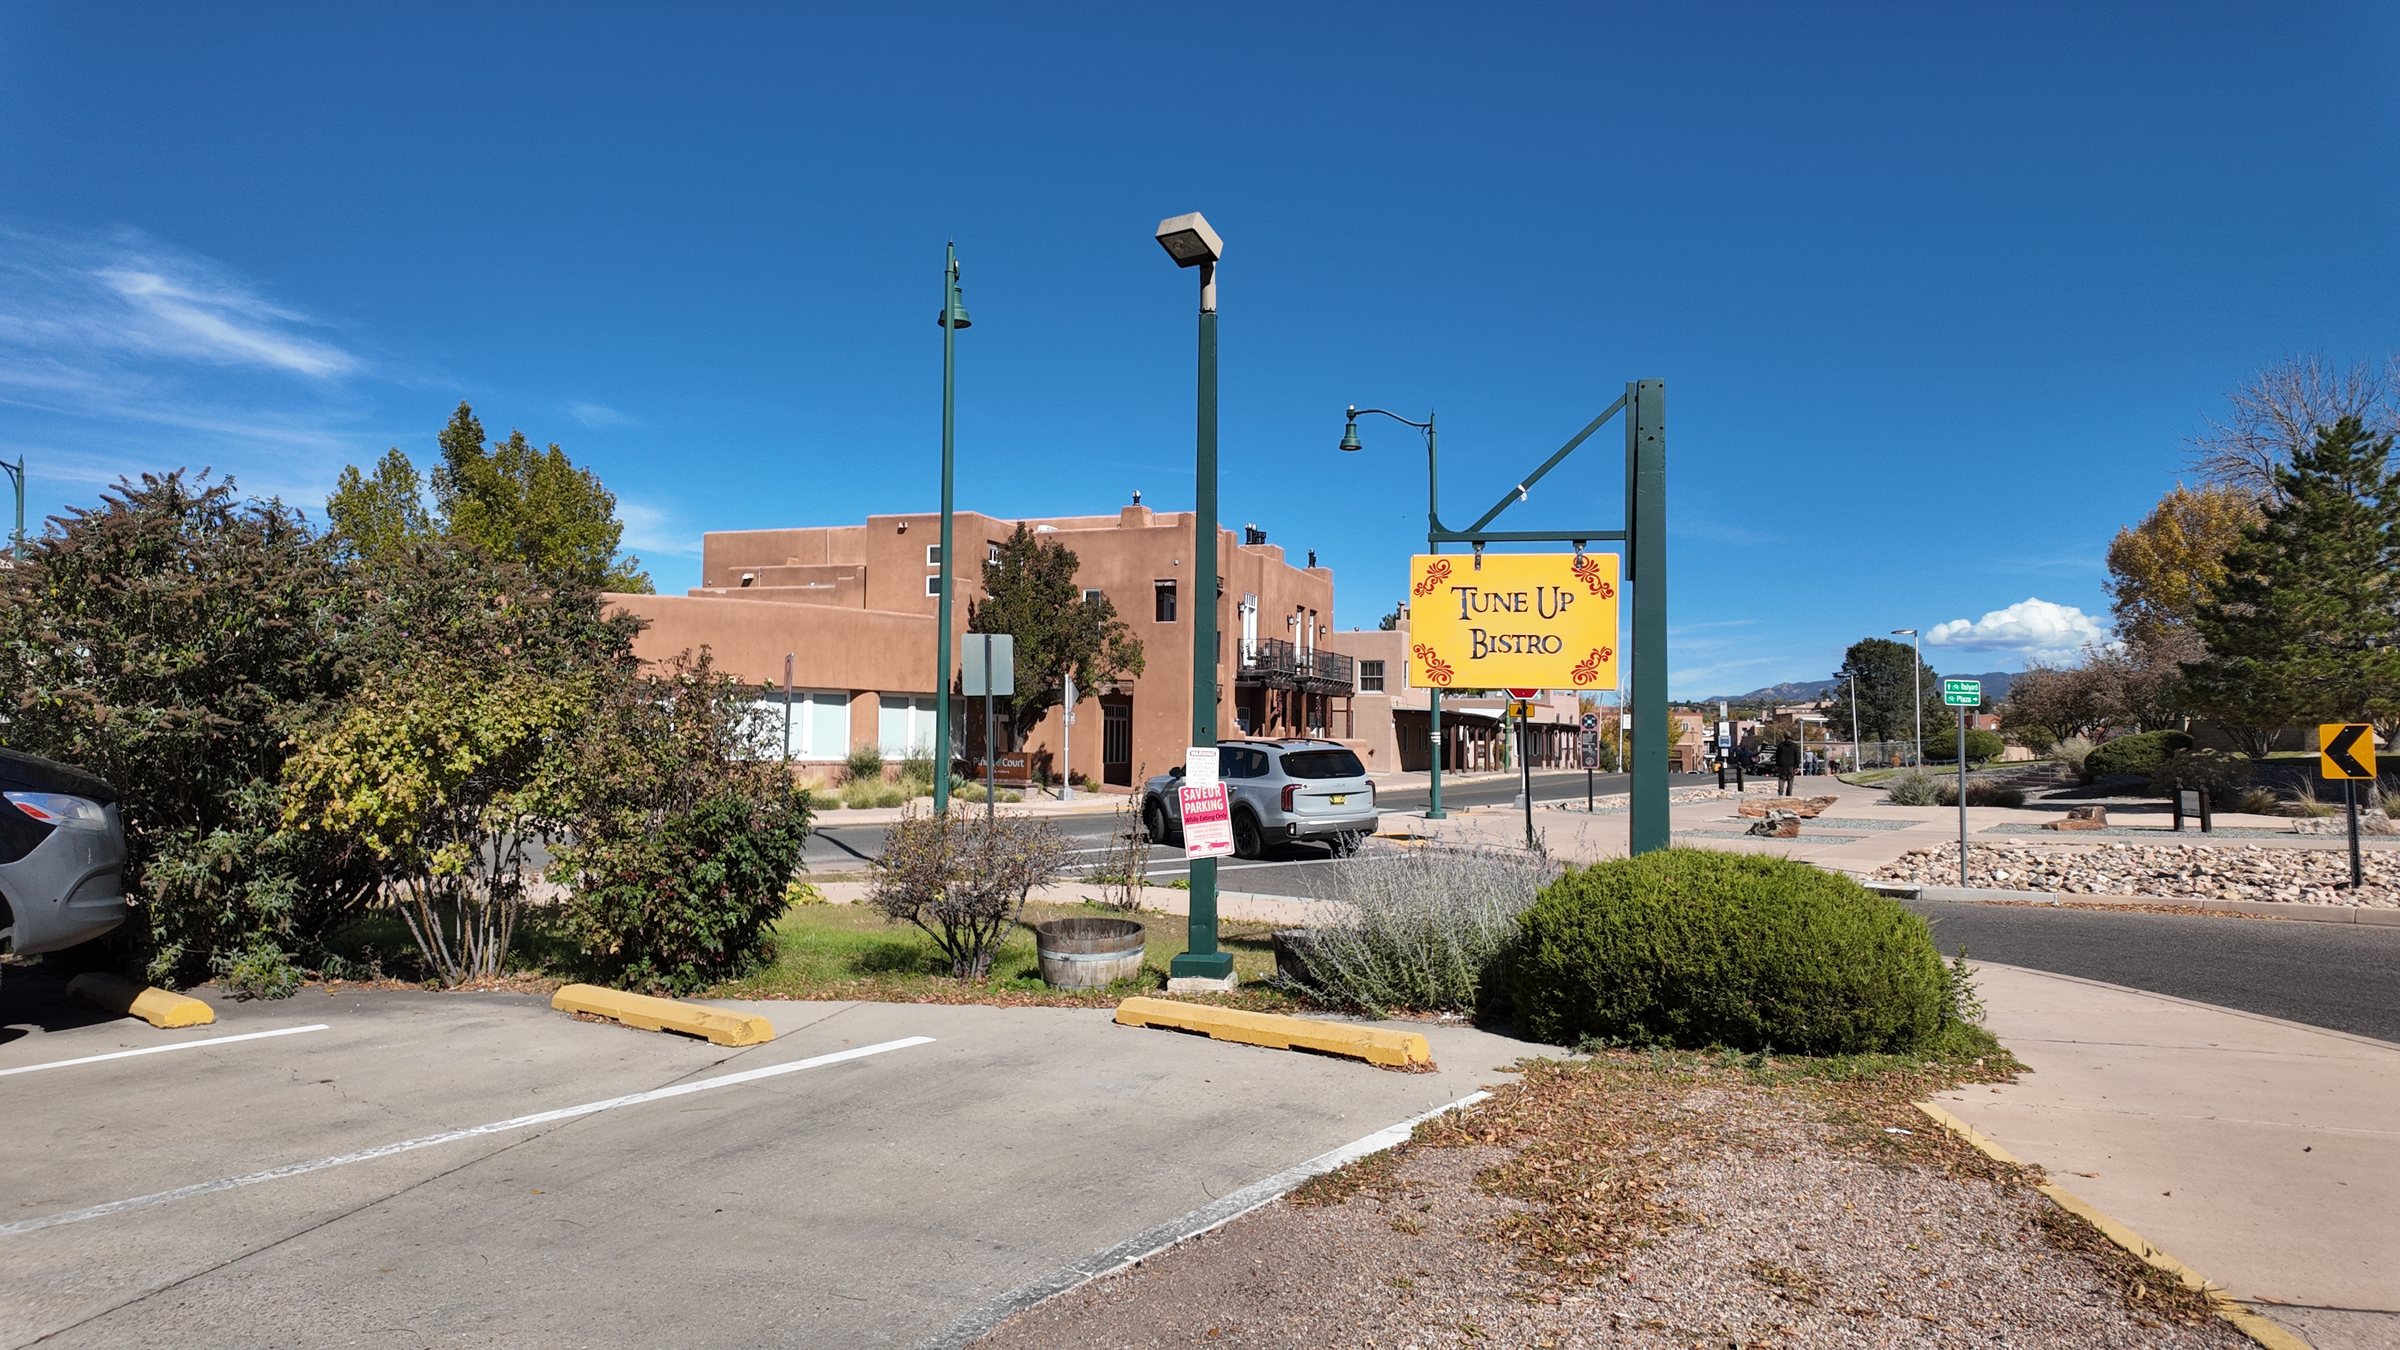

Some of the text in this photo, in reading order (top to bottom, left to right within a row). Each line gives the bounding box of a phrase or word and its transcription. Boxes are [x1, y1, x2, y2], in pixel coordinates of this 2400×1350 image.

[1450, 586, 1575, 621] TUNE UP
[1468, 628, 1563, 660] BISTRO
[1957, 695, 1971, 703] Plaza
[1002, 758, 1024, 767] Court
[1184, 786, 1221, 801] SAVEUR
[1185, 799, 1224, 814] PARKING
